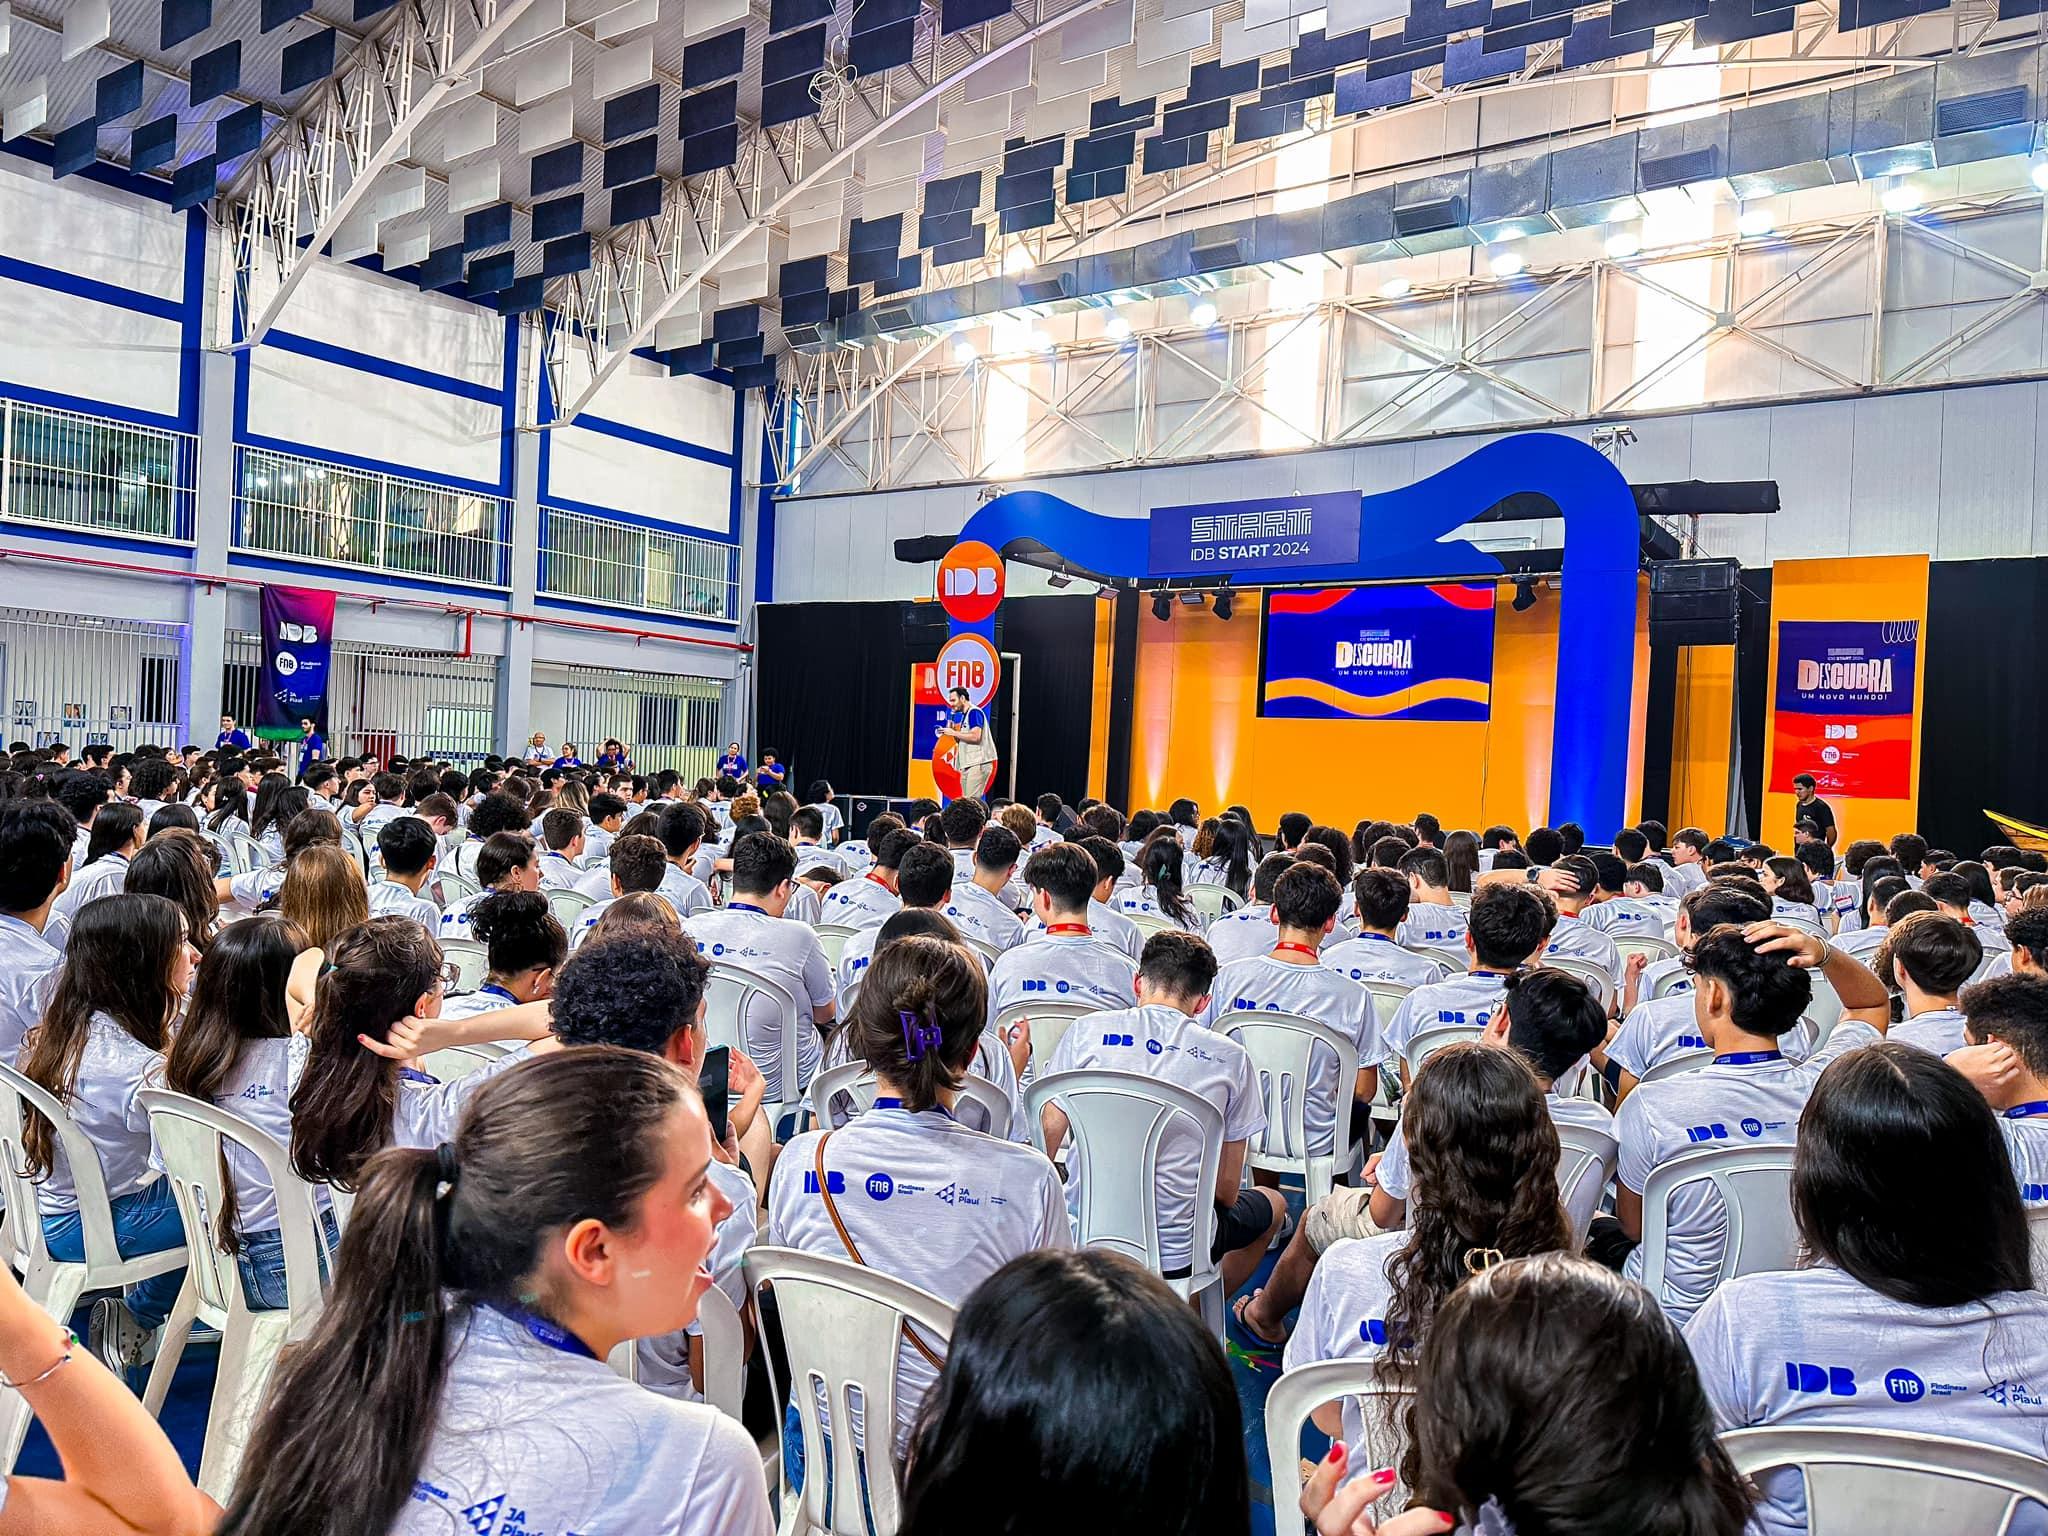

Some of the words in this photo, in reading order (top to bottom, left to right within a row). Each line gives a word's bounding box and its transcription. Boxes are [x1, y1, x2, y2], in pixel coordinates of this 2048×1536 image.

[1191, 508, 1312, 543] START
[1190, 548, 1215, 561] IDB
[1218, 544, 1270, 559] START
[1272, 541, 1310, 556] 2024
[944, 567, 997, 596] IDB
[280, 621, 317, 643] IDB
[1335, 639, 1413, 669] DESCUBRA
[946, 661, 985, 688] FNB
[1797, 658, 1892, 693] DESCUBRA
[1825, 724, 1858, 739] IDB
[1022, 980, 1047, 991] IDB
[1438, 1010, 1466, 1024] IDB
[1102, 1033, 1134, 1047] IDB
[1686, 1123, 1729, 1142] IDB
[869, 1181, 890, 1193] FNB
[959, 1188, 970, 1196] JA
[1785, 1362, 1857, 1396] IDB
[1890, 1378, 1919, 1395] FNB
[2011, 1384, 2026, 1393] JA
[504, 1507, 526, 1525] JA
